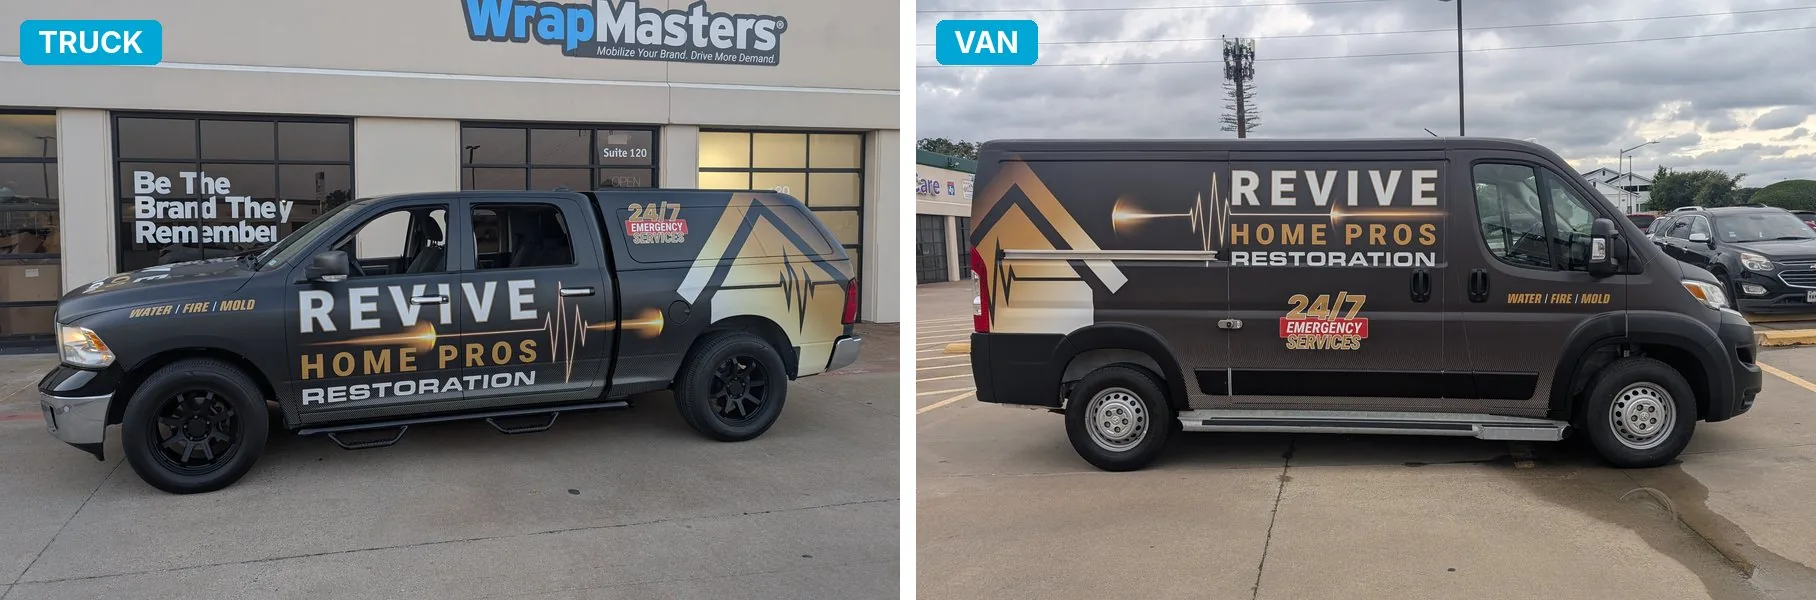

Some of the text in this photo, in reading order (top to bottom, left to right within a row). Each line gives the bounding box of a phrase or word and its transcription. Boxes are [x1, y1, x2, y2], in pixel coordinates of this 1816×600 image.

[596, 46, 776, 64] Mobilize Your Brand. Drive More Demand.
[603, 148, 648, 158] Suite 120
[133, 170, 231, 195] Be The
[611, 175, 641, 187] OPEN
[1231, 169, 1438, 207] REVIVE
[134, 195, 294, 224] Brand They
[628, 201, 680, 222] 24/7
[631, 222, 683, 232] EMERGENCY
[1231, 223, 1437, 246] HOME PROS
[633, 232, 685, 244] SERVICES
[1231, 251, 1436, 267] RESTORATION
[299, 279, 538, 334] REVIVE
[1285, 291, 1367, 322] 24/7
[1507, 293, 1542, 304] WATER
[1550, 293, 1573, 304] FIRE
[1581, 293, 1611, 304] MOLD
[129, 305, 173, 319] WATER
[182, 301, 210, 314] FIRE
[219, 299, 256, 312] MOLD
[1286, 321, 1363, 334] EMERGENCY
[1285, 333, 1362, 350] SERVICES
[301, 339, 537, 380] HOME PROS
[302, 370, 536, 406] RESTORATION
